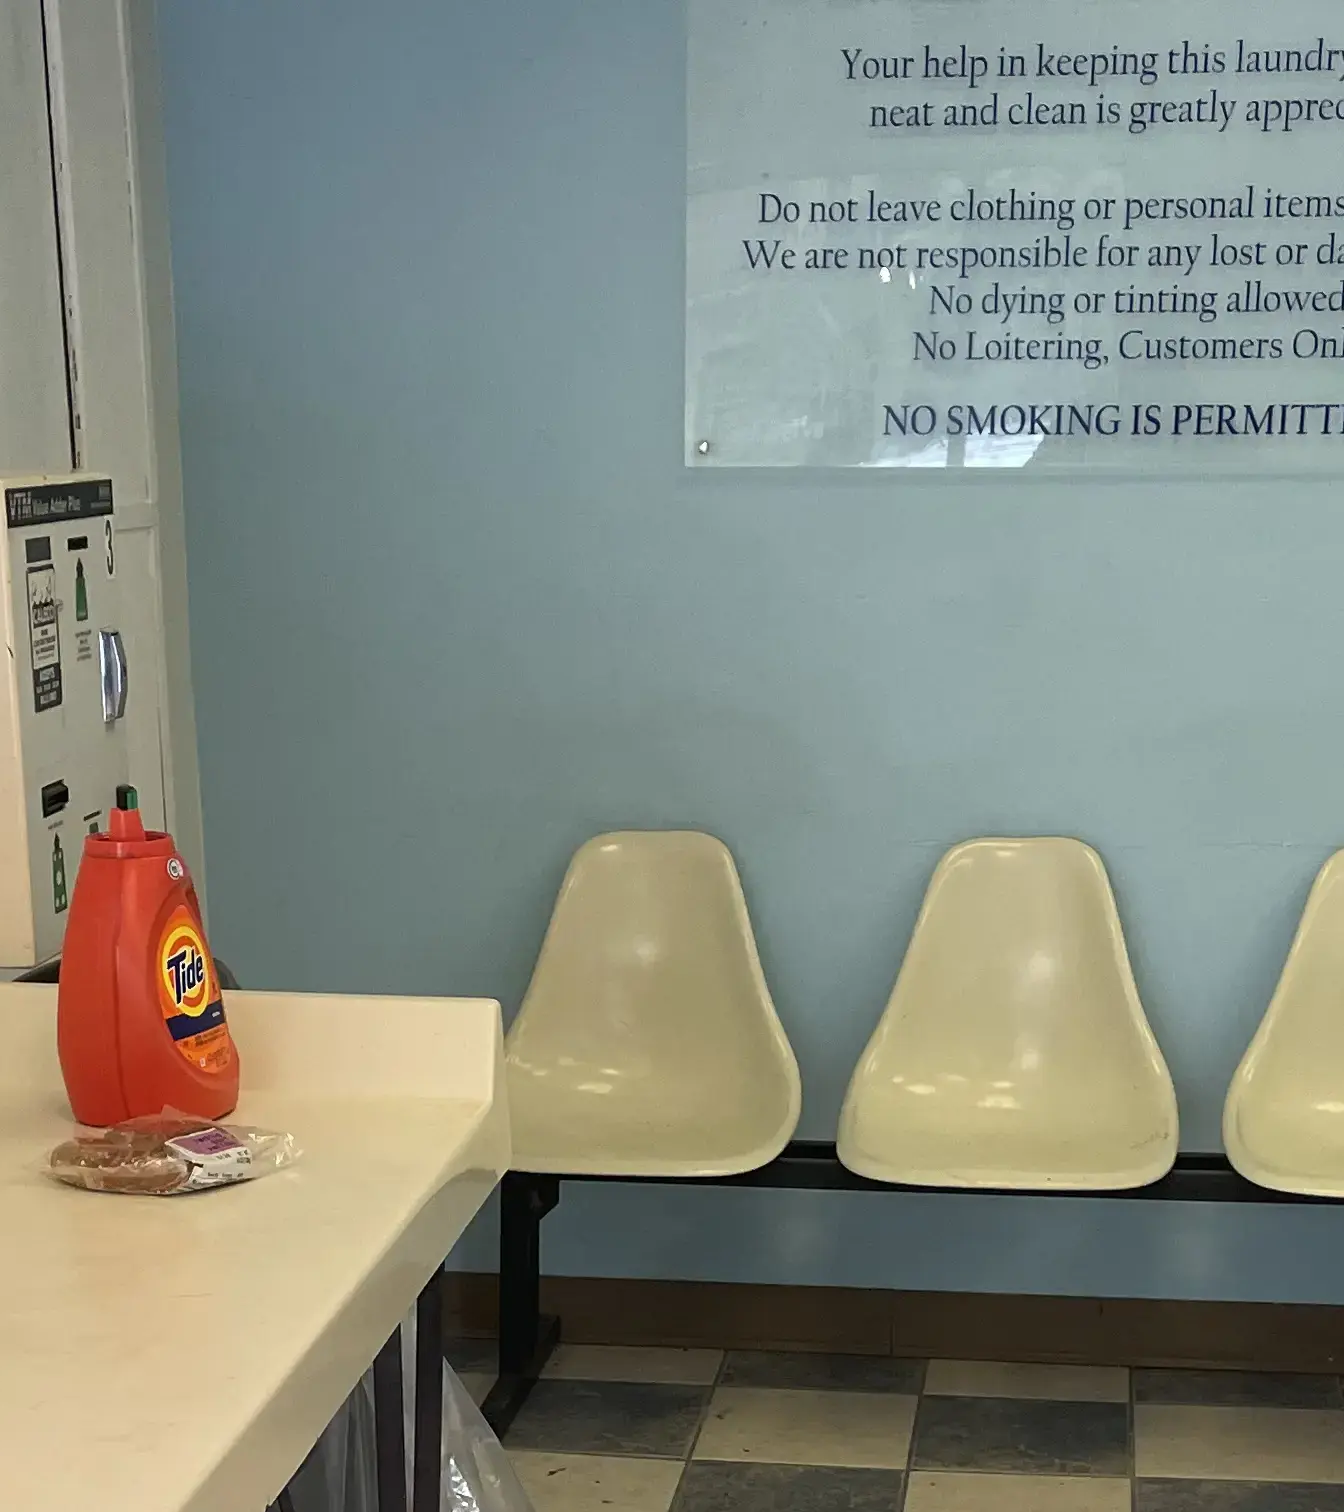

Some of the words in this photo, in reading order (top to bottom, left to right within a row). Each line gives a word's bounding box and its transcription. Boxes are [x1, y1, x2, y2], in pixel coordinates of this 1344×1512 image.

[840, 48, 914, 79] Your
[922, 45, 987, 88] help
[996, 47, 1026, 77] in
[1036, 43, 1159, 86] keeping
[1168, 40, 1226, 75] this
[869, 102, 934, 127] neat
[943, 93, 999, 126] and
[1008, 92, 1088, 125] clean
[1096, 94, 1121, 124] is
[1129, 90, 1236, 134] greatly
[758, 193, 800, 223] Do
[810, 198, 858, 222] not
[867, 190, 941, 222] leave
[950, 189, 1076, 230] clothing
[1084, 198, 1116, 220] or
[1124, 186, 1254, 230] personal
[743, 239, 796, 269] We
[804, 248, 849, 269] are
[857, 243, 907, 269] not
[916, 236, 1087, 278] responsible
[1097, 235, 1139, 267] for
[1148, 244, 1202, 275] any
[1210, 234, 1267, 266] lost
[1275, 243, 1308, 265] or
[929, 285, 973, 315] No
[981, 282, 1065, 324] dying
[1073, 292, 1106, 314] or
[1114, 285, 1218, 322] tinting
[912, 331, 956, 361] No
[965, 331, 1109, 370] Loitering,
[1118, 331, 1283, 361] Customers
[882, 404, 937, 436] NO
[945, 404, 1121, 436] SMOKING
[1131, 404, 1161, 436] IS
[105, 519, 114, 576] 3
[167, 949, 204, 1005] Tide
